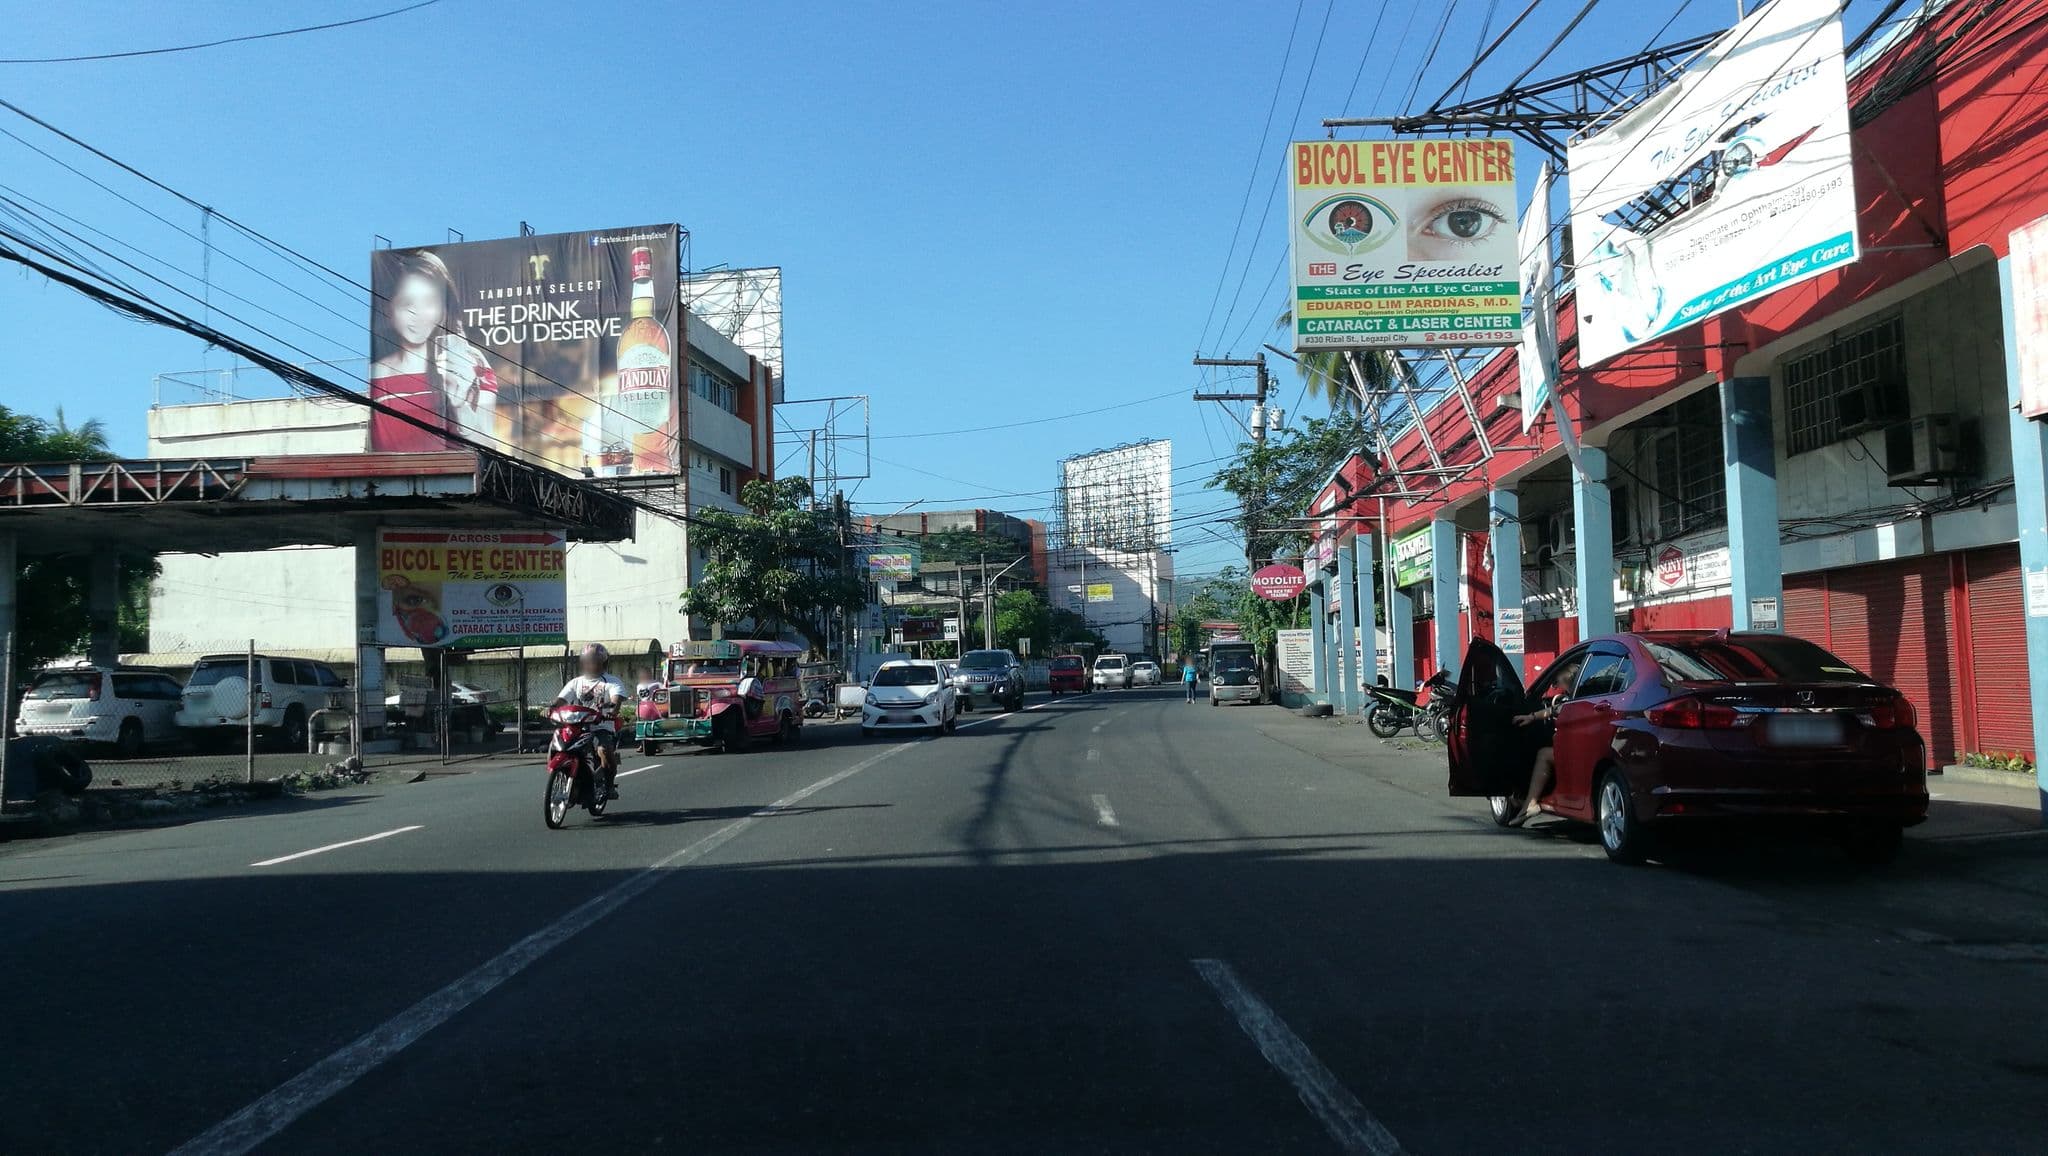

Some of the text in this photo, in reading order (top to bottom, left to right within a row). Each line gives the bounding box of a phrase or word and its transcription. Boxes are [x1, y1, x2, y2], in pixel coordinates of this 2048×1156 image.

[1298, 142, 1513, 185] BICOL EYE CENTER
[1311, 263, 1503, 283] THE Eye Specialist
[1752, 267, 1778, 288] Art
[1779, 255, 1807, 278] Eye
[1811, 242, 1850, 264] Care
[480, 280, 601, 300] TANDUAY SELECT
[1325, 287, 1361, 295] State
[1365, 286, 1381, 294] of
[1383, 285, 1405, 294] the
[1409, 285, 1430, 293] Art
[1434, 284, 1458, 295] Eye
[1461, 284, 1493, 293] Care
[1306, 297, 1512, 311] EDUARDO LIM PARDIÑAS, M.D.
[464, 300, 581, 327] THE DRINK
[480, 317, 622, 346] YOU DESERVE
[1306, 316, 1513, 332] CATARACT & LASER CENTER
[1305, 335, 1324, 344] #330
[1325, 335, 1344, 343] Rizal
[1361, 335, 1391, 344] Legazpi
[1393, 334, 1409, 344] City
[1438, 331, 1514, 341] 480-6193
[619, 368, 669, 391] TANDUAY
[624, 391, 665, 402] SELECT
[450, 534, 499, 543] ACROSS
[381, 549, 564, 571] BICOL EYE CENTER
[448, 570, 560, 581] The Eye Specialist
[1253, 576, 1303, 586] MOTOLITE
[453, 624, 495, 634] CATARACT
[497, 624, 503, 633] &
[533, 622, 565, 633] CENTER
